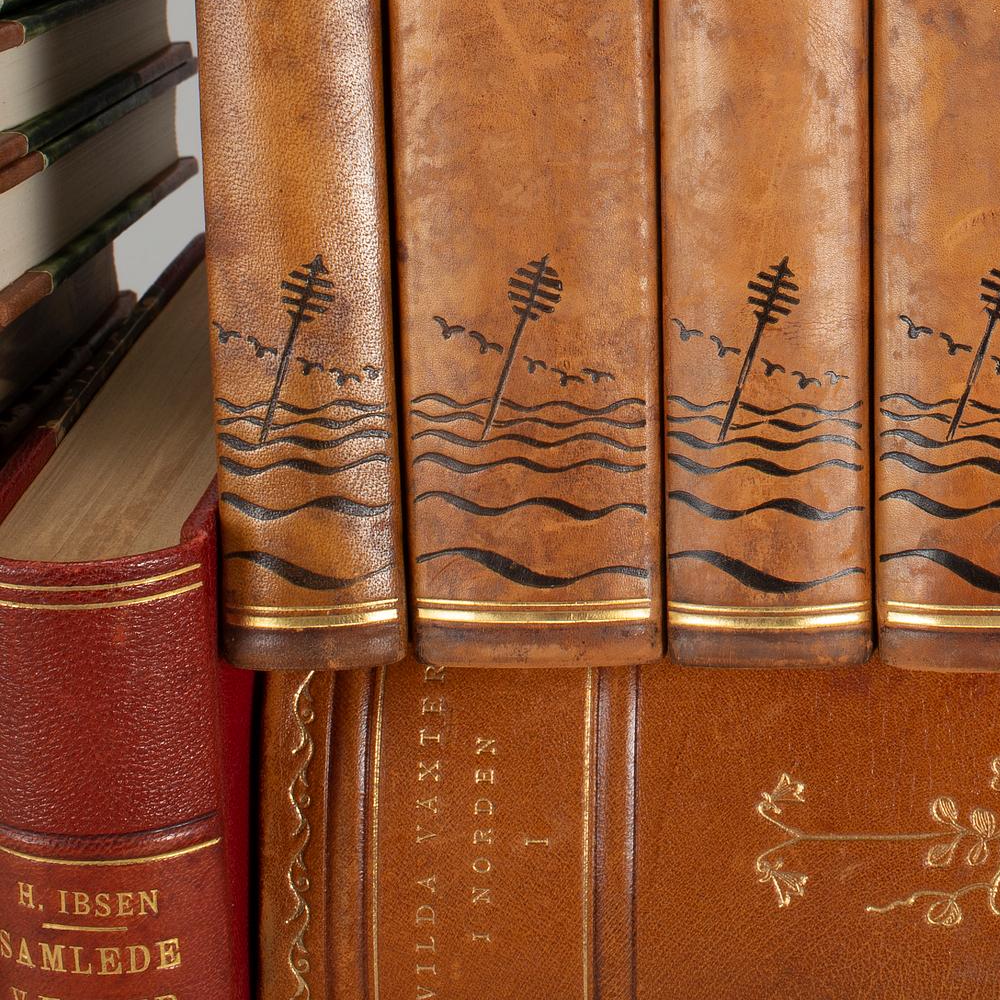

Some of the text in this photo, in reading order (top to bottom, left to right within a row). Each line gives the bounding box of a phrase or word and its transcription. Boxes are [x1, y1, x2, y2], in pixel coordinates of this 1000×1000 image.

[472, 737, 497, 903] NORDEN
[17, 881, 159, 918] H. IBSEN
[415, 873, 437, 1000] VILDA
[0, 929, 182, 975] SAMLEDE
